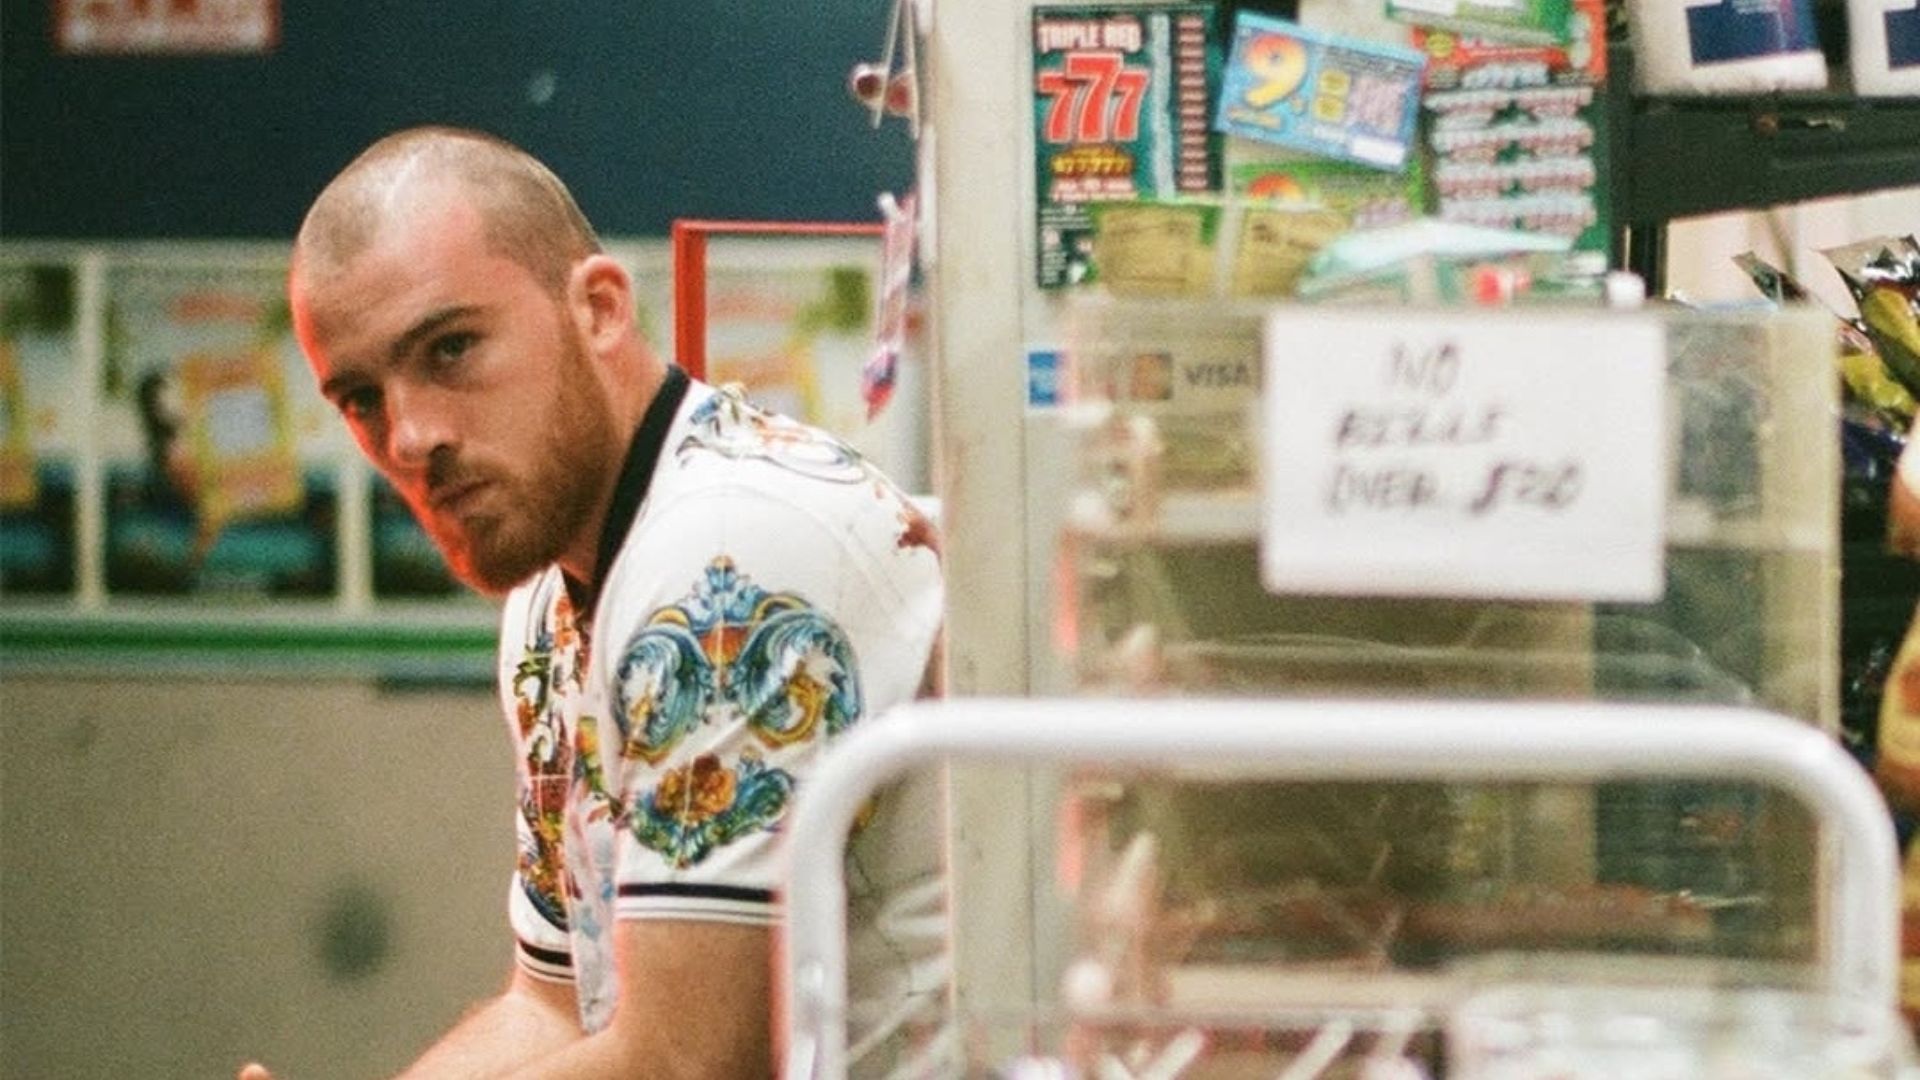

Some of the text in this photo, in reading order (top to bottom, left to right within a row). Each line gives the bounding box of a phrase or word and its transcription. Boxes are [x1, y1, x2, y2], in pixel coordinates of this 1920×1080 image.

[1038, 16, 1141, 53] TRIPLE RED
[1038, 52, 1149, 142] 777
[1184, 362, 1252, 387] VISA
[1390, 343, 1459, 395] NO
[1327, 461, 1584, 514] OVER $20
